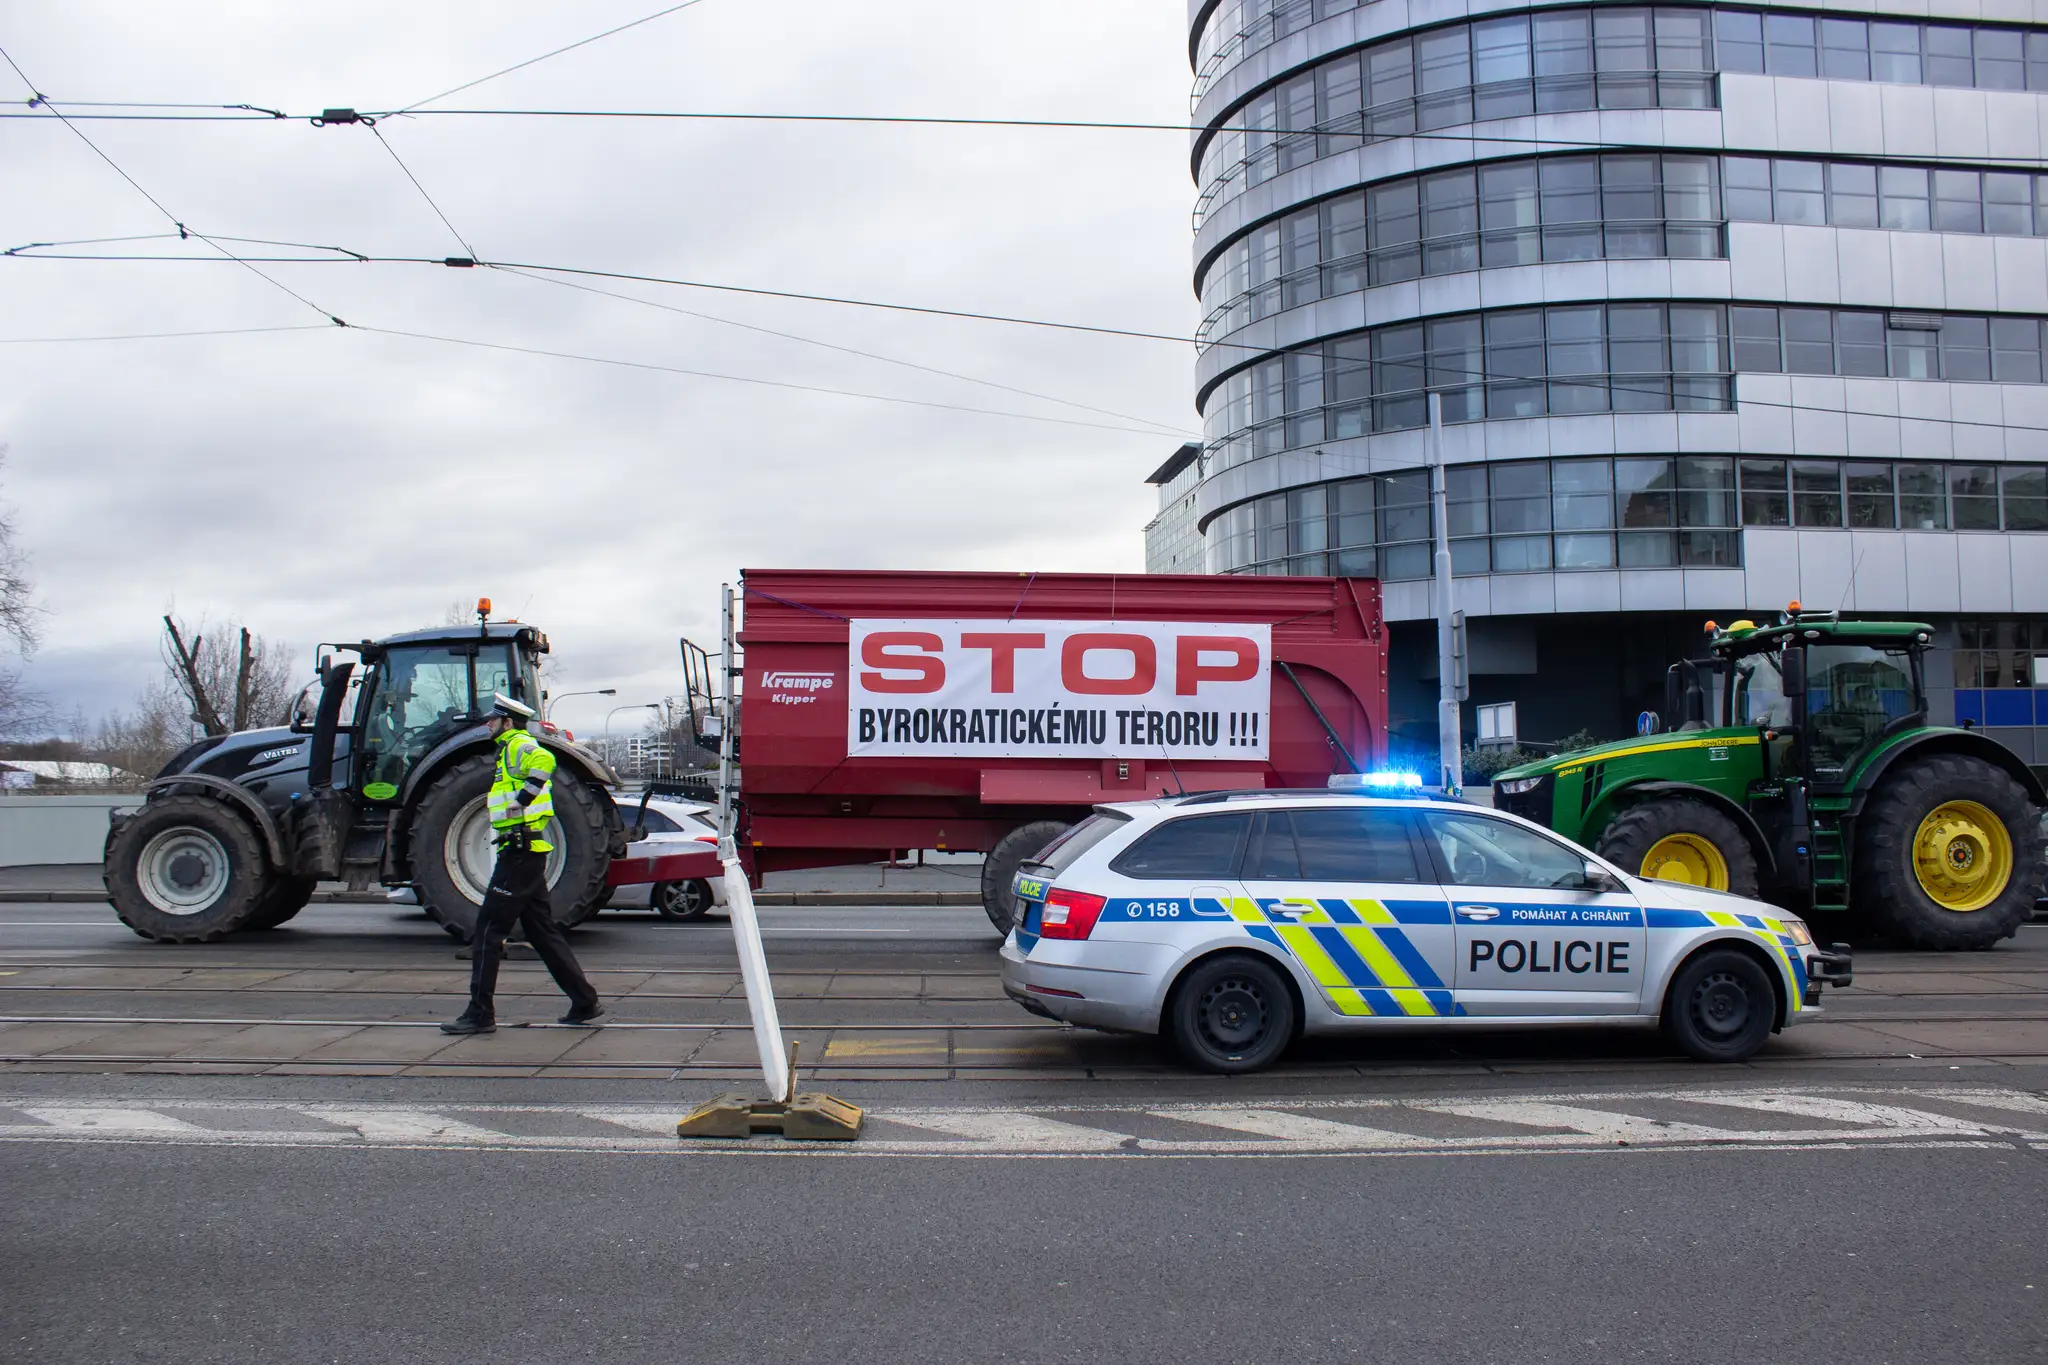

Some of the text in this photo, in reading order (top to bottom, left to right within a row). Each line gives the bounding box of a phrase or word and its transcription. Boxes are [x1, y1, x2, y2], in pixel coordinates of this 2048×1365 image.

[859, 631, 1260, 696] STOP
[761, 671, 835, 692] Krampe
[771, 693, 817, 705] Kipper
[858, 701, 1259, 747] BYROKRATICKÉMU TERORU !!!
[263, 747, 299, 759] VALTRA
[1146, 902, 1180, 917] 158
[1512, 908, 1630, 921] POMÁHAT A CHRÁNIT
[1469, 939, 1630, 974] POLICIE
